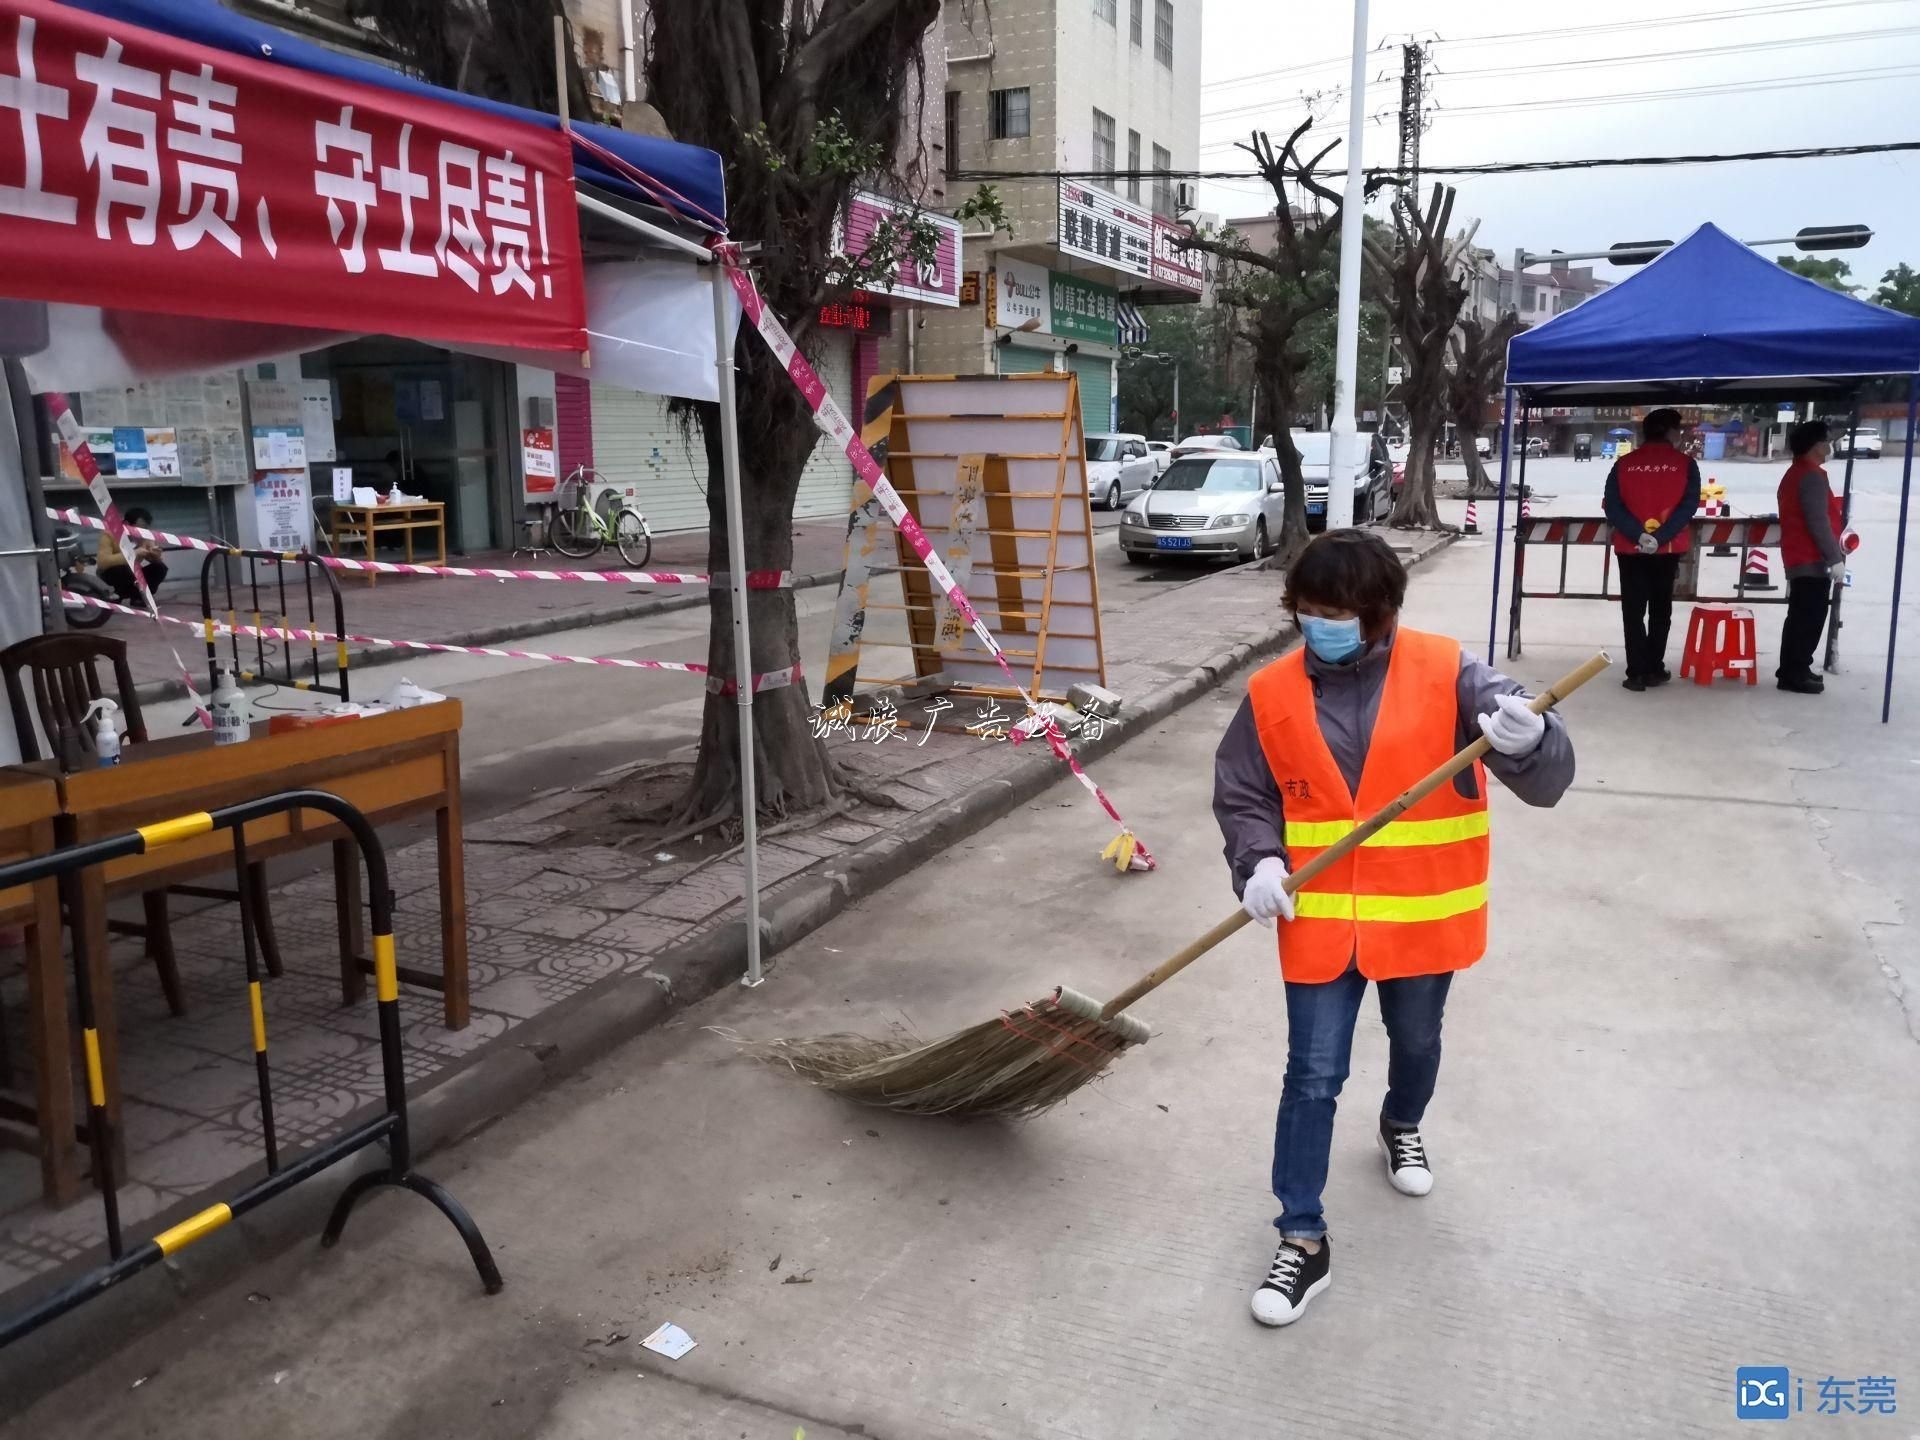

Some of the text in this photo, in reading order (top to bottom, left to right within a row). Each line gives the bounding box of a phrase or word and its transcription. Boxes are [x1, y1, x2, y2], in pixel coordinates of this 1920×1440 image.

[1053, 281, 1116, 322] 创意五金电器
[1627, 463, 1678, 472] 以人民为中心
